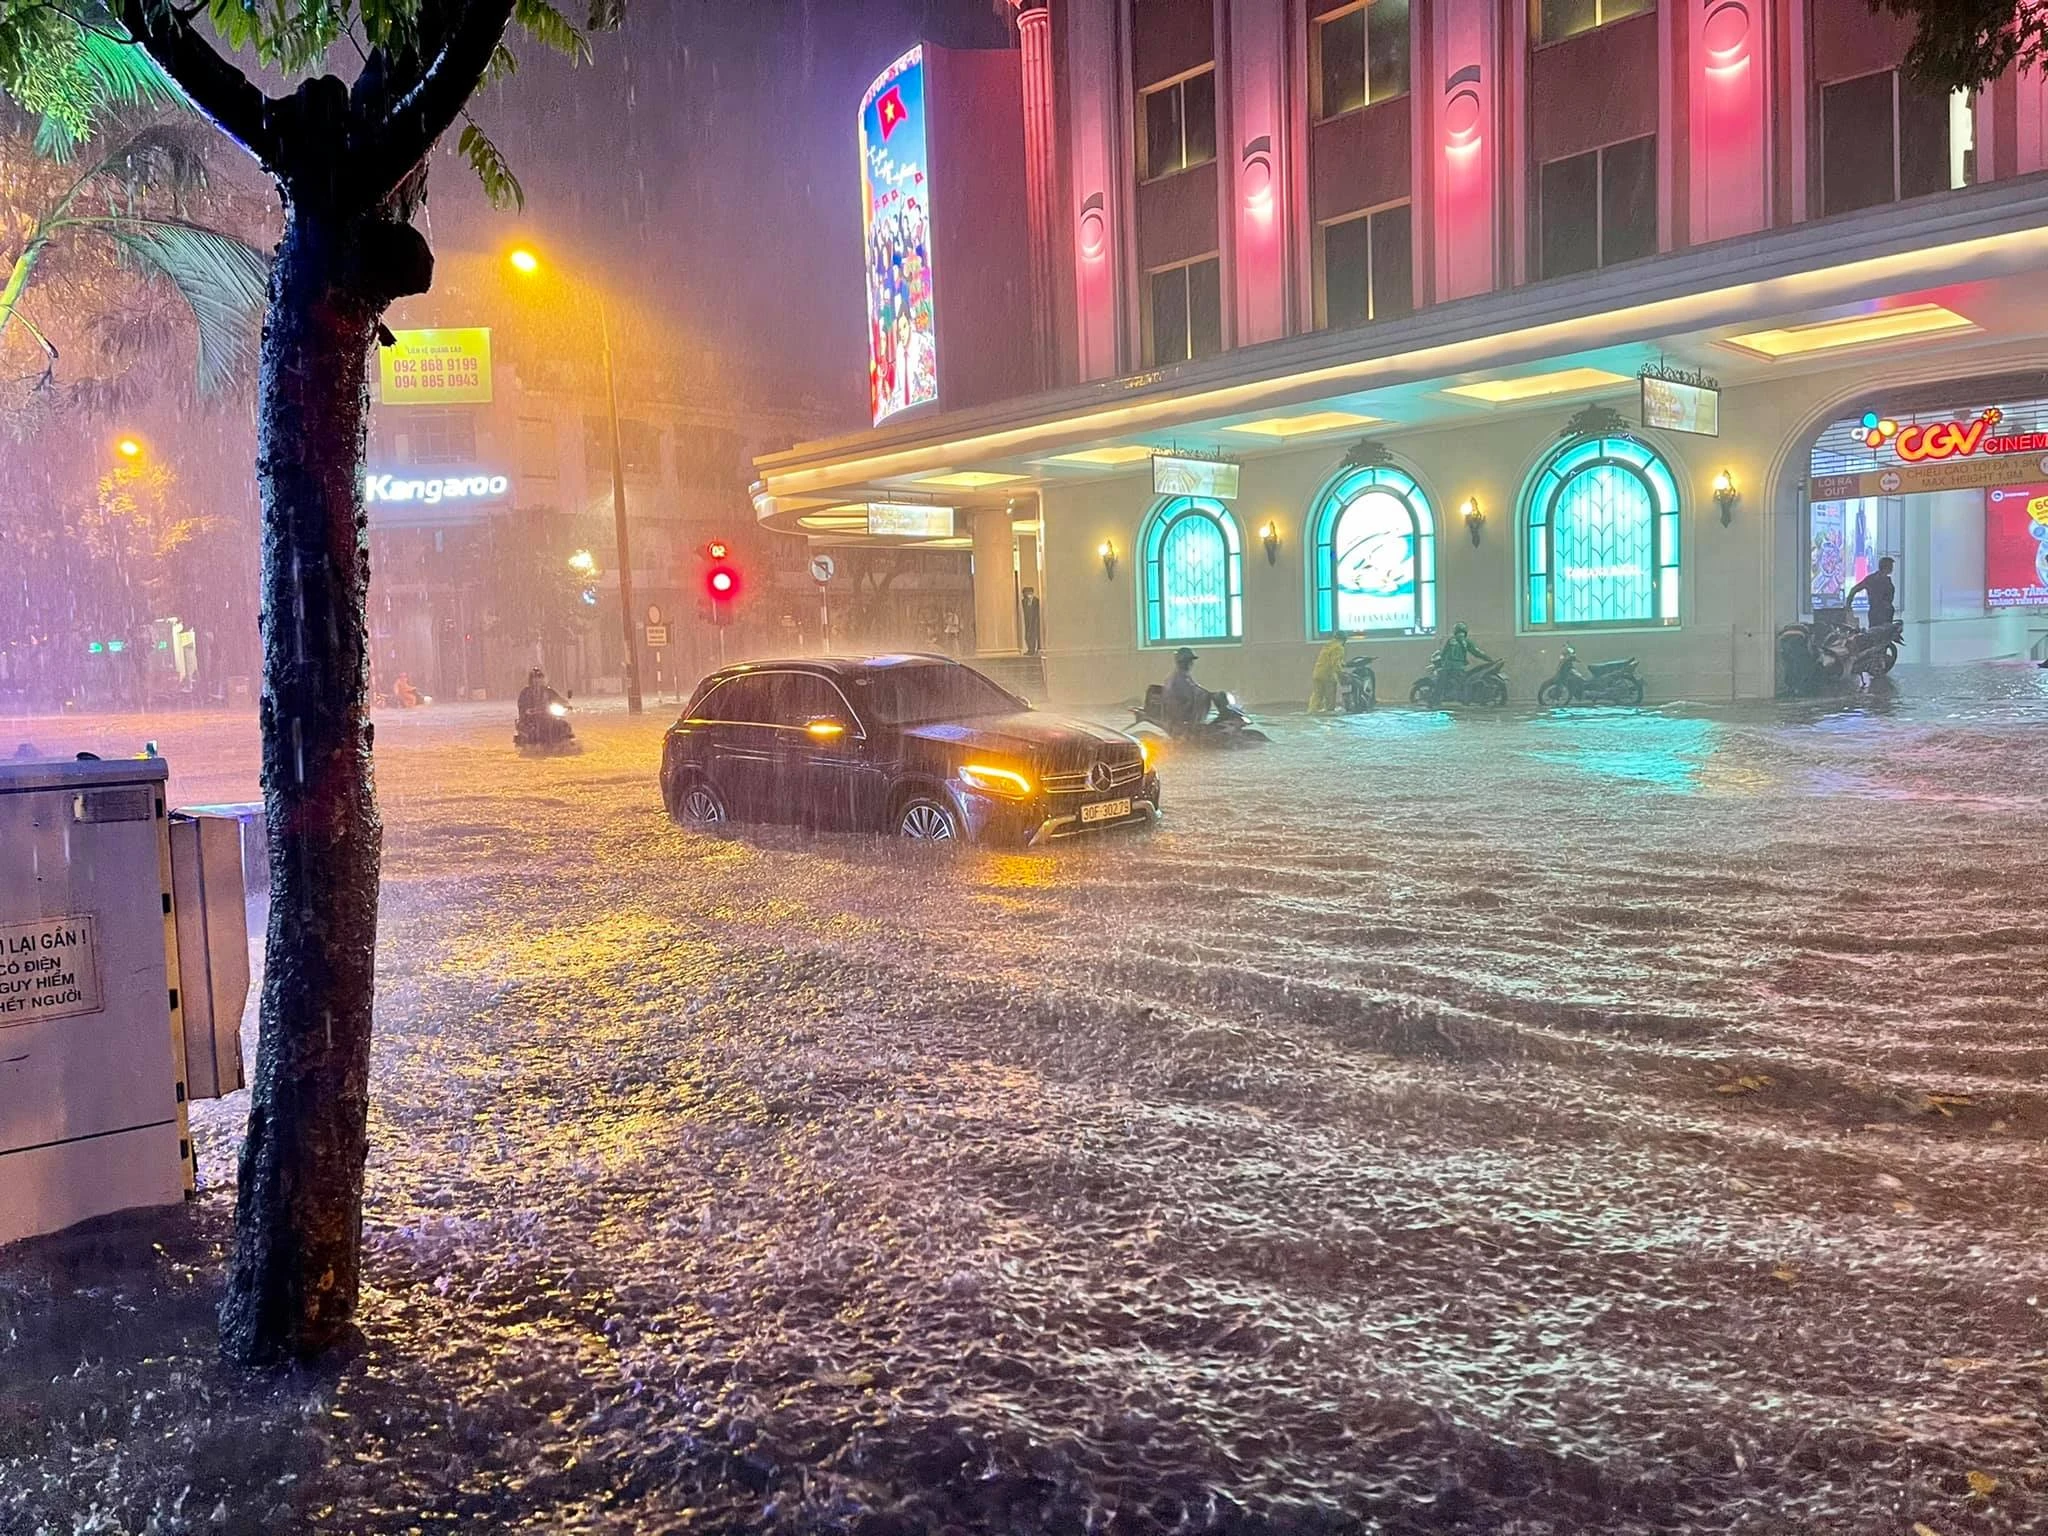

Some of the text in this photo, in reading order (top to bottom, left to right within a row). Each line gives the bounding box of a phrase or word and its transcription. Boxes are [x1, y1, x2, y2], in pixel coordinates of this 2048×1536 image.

[394, 359, 417, 372] 092
[447, 357, 478, 371] 9199
[395, 375, 417, 388] 094
[448, 374, 479, 387] 0943
[1898, 420, 1986, 461] CGV
[366, 474, 508, 503] Kangaroo
[1824, 486, 1847, 497] OUT
[9, 935, 36, 956] LẠI
[41, 926, 77, 949] GẦN
[24, 956, 61, 973] ĐIỆN
[36, 969, 75, 990] HIỂM
[32, 988, 82, 1008] NGƯỜI
